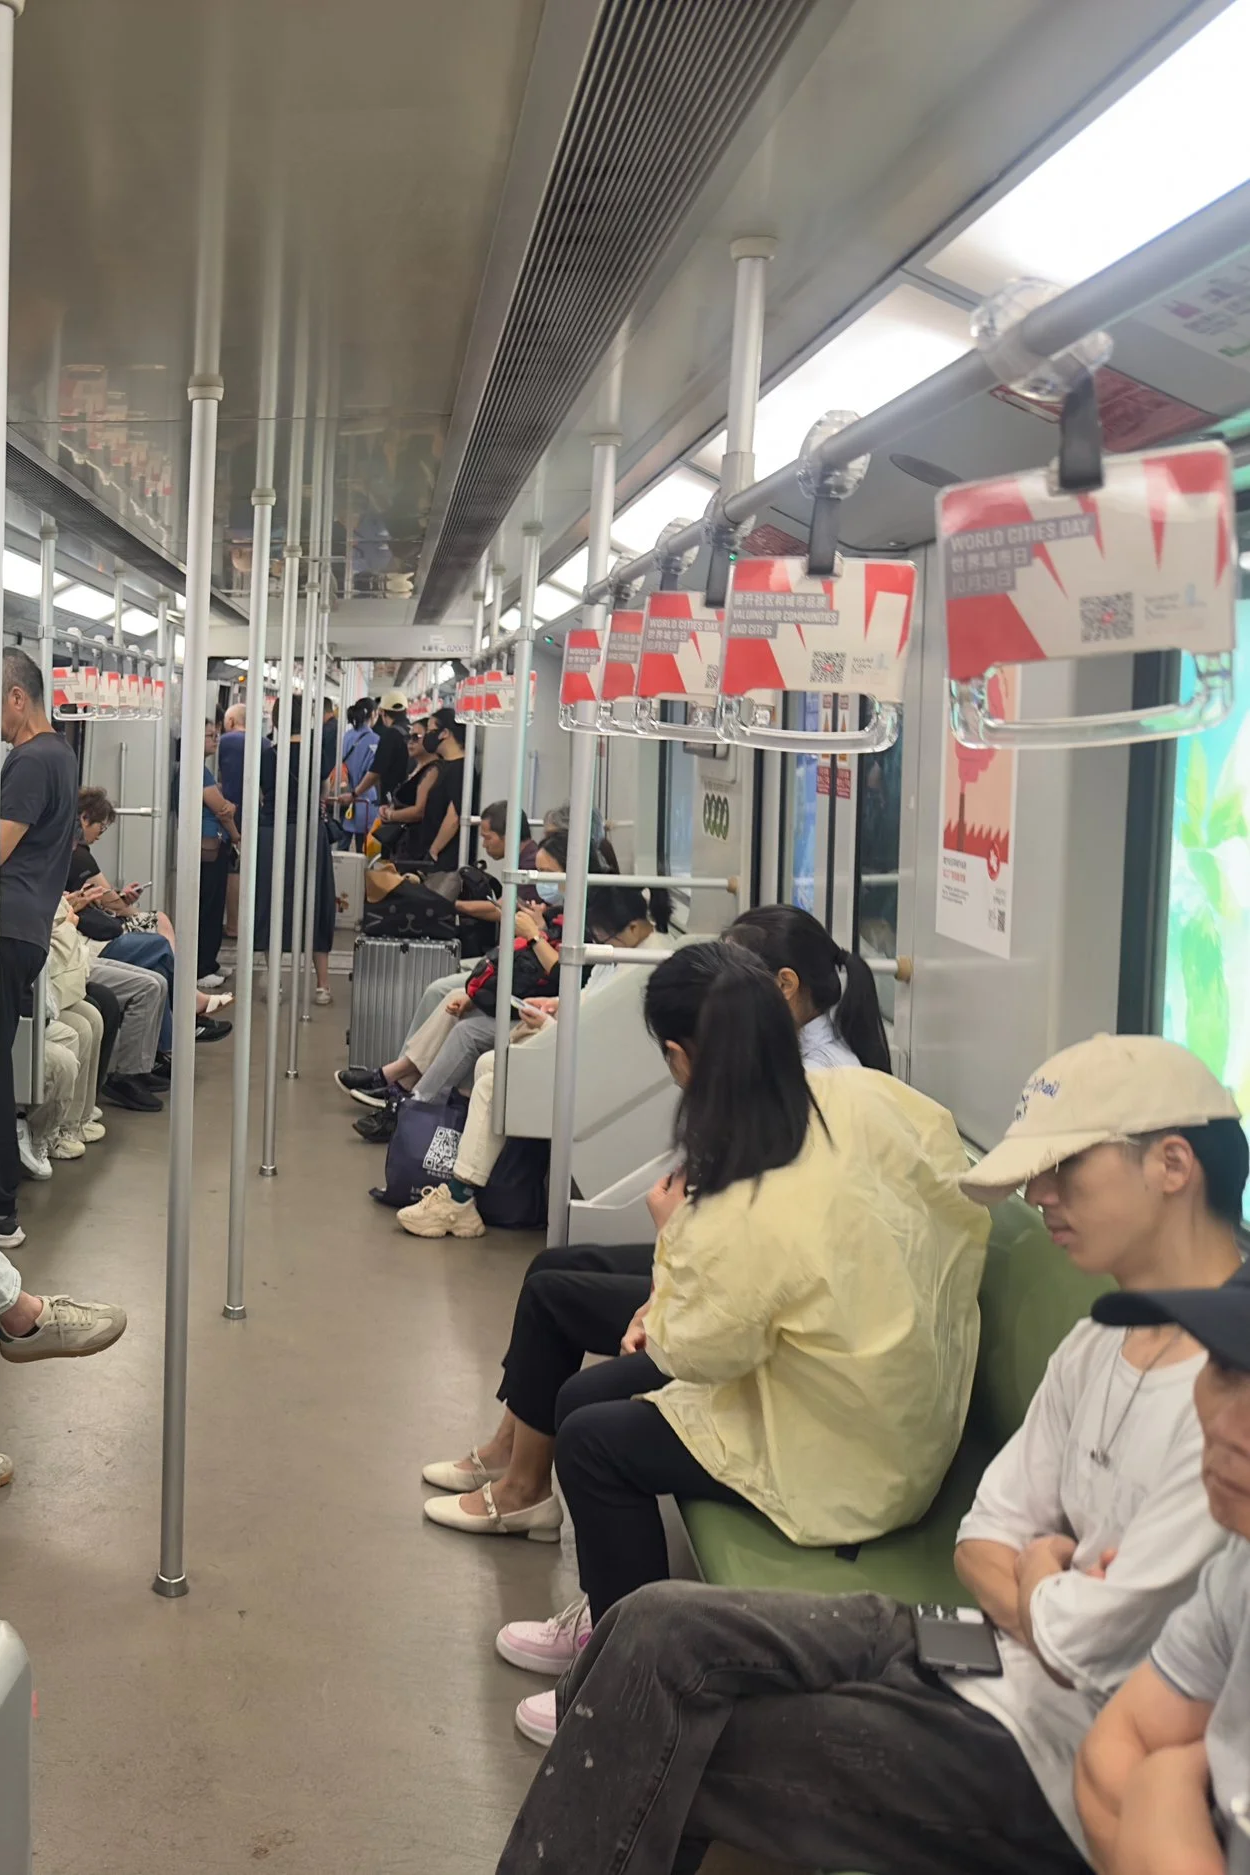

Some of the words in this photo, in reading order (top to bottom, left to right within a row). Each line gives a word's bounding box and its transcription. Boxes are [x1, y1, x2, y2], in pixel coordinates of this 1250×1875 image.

[950, 530, 1003, 552] WORLD
[1008, 522, 1056, 544] CITIES
[1059, 518, 1090, 536] DAY
[951, 547, 1028, 573] 世界城市日
[952, 570, 1012, 593] 10月31日
[649, 618, 677, 629] WORLD
[677, 620, 703, 631] CITIES
[704, 621, 720, 631] DAY
[733, 609, 765, 620] VALUING
[765, 610, 782, 621] OUR
[783, 611, 837, 624] COMMUNITIES
[730, 623, 747, 634] AND
[748, 624, 773, 635] CITIES
